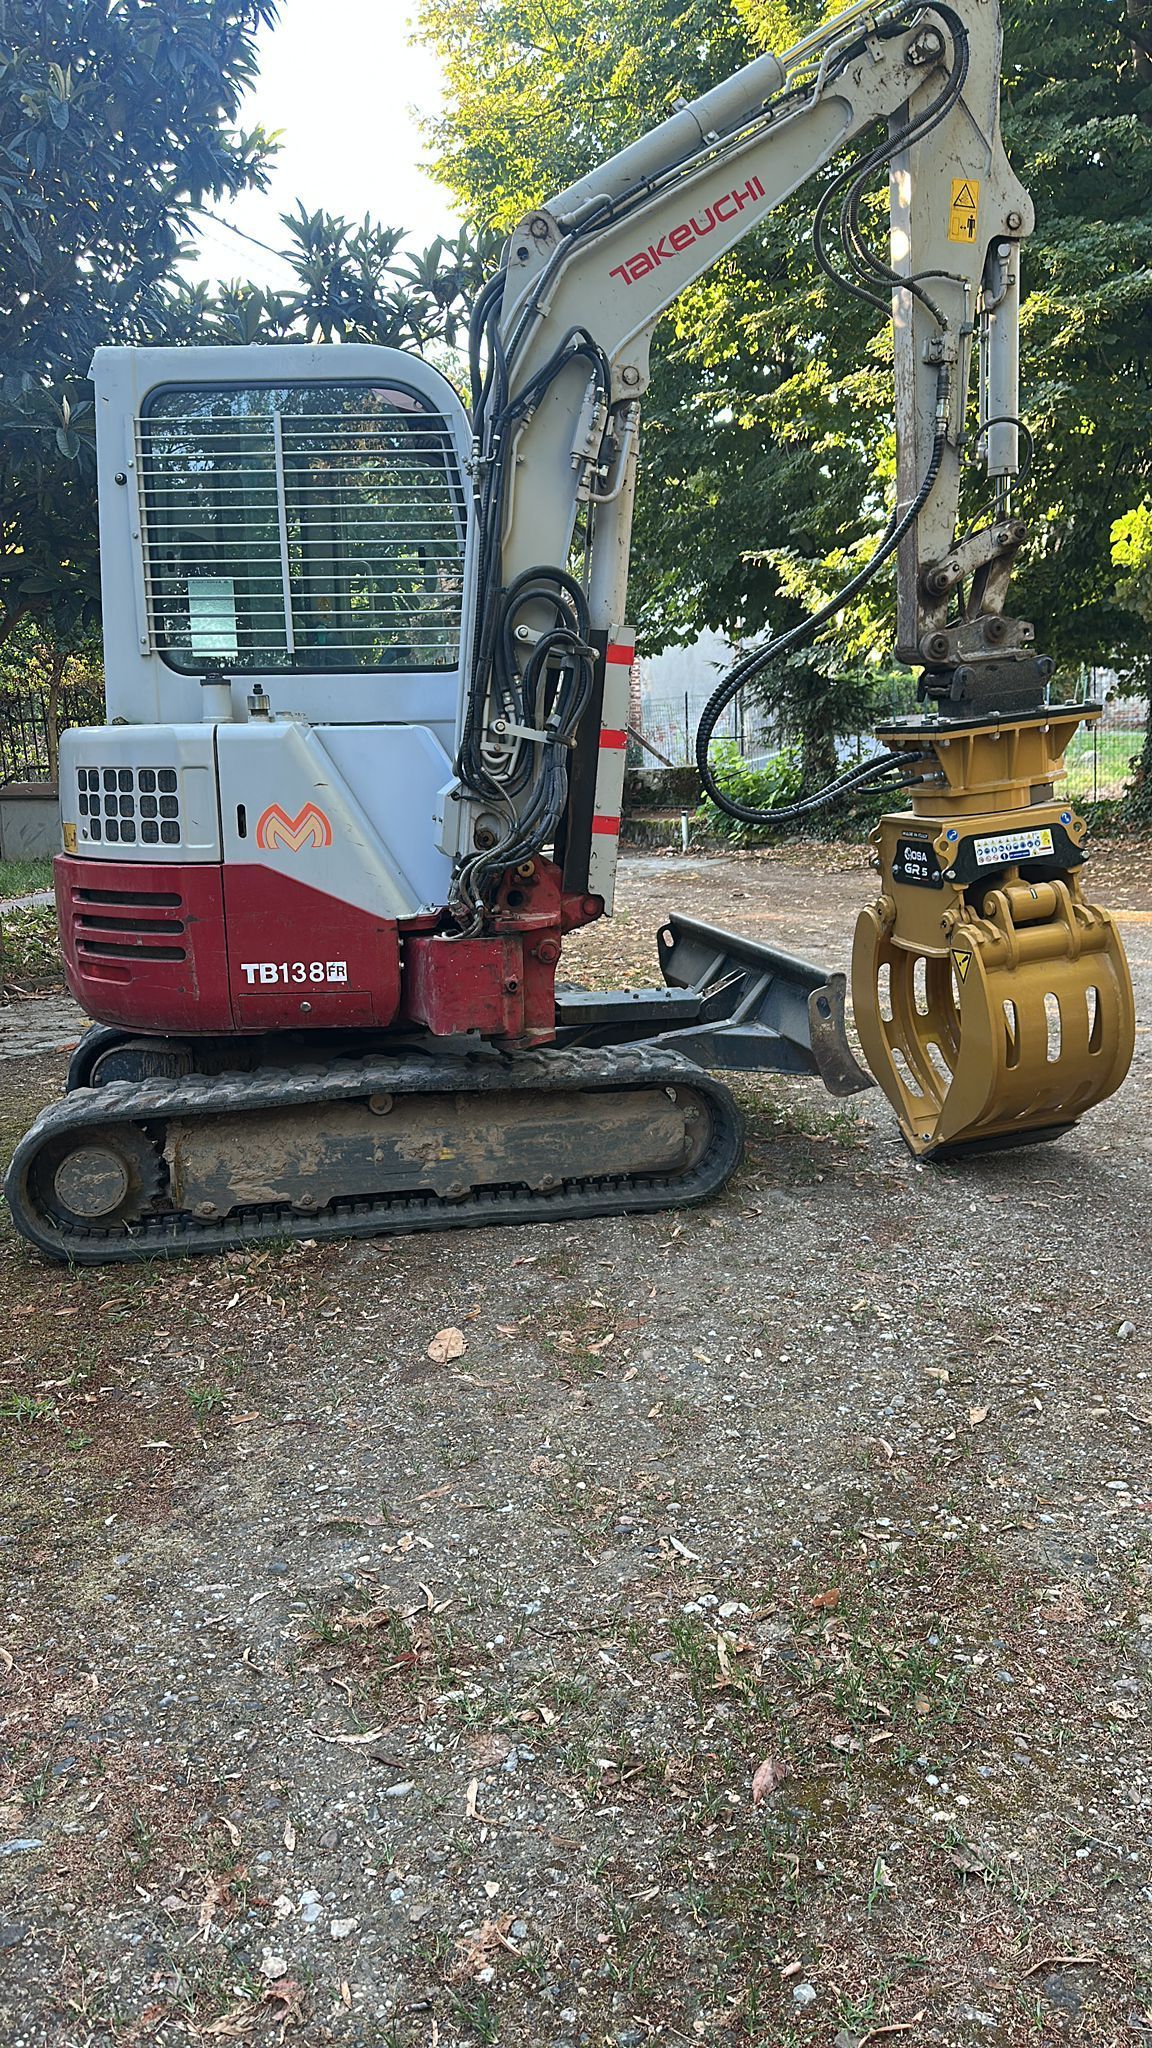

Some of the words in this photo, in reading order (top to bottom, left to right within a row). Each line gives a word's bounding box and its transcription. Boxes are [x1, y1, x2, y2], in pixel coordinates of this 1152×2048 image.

[608, 175, 766, 286] TAKEUCHI
[904, 862, 920, 875] GR
[240, 961, 325, 984] TB138
